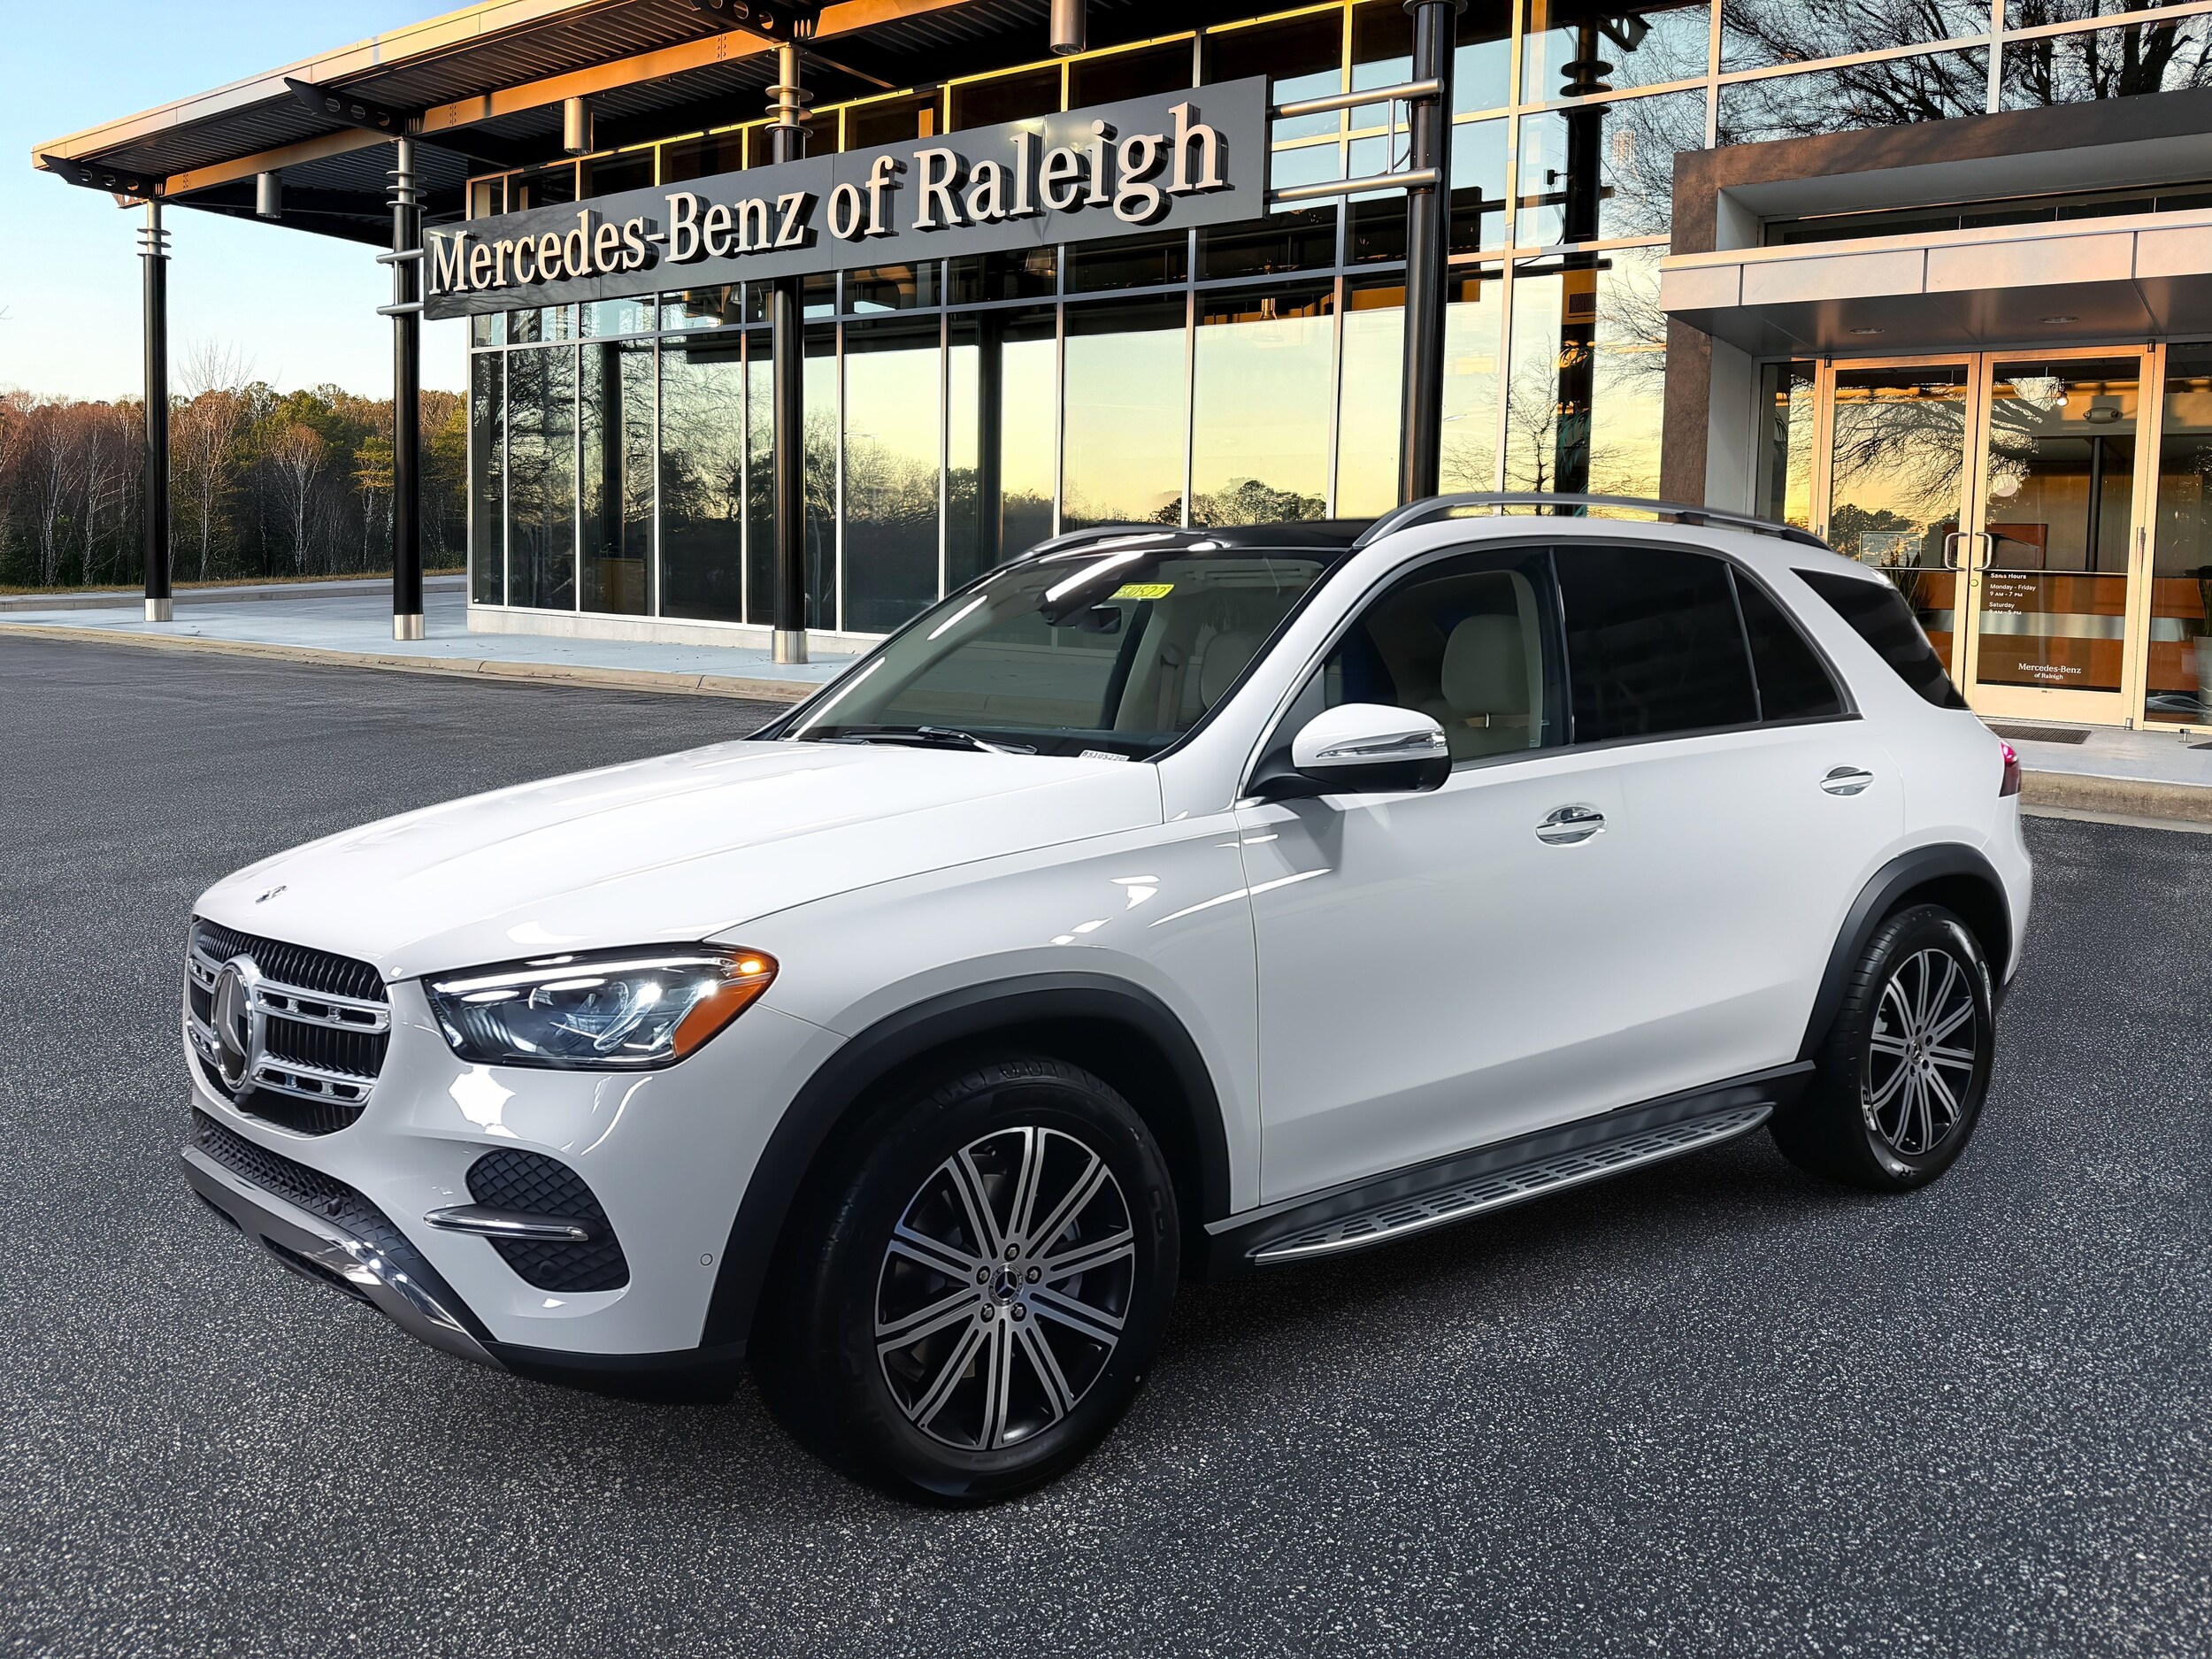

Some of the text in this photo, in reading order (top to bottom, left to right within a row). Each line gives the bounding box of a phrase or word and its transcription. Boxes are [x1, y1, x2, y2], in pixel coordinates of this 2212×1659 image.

[428, 102, 1224, 296] Mercedes-Benz of Raleigh
[2018, 663, 2081, 673] Mercedes-Benz
